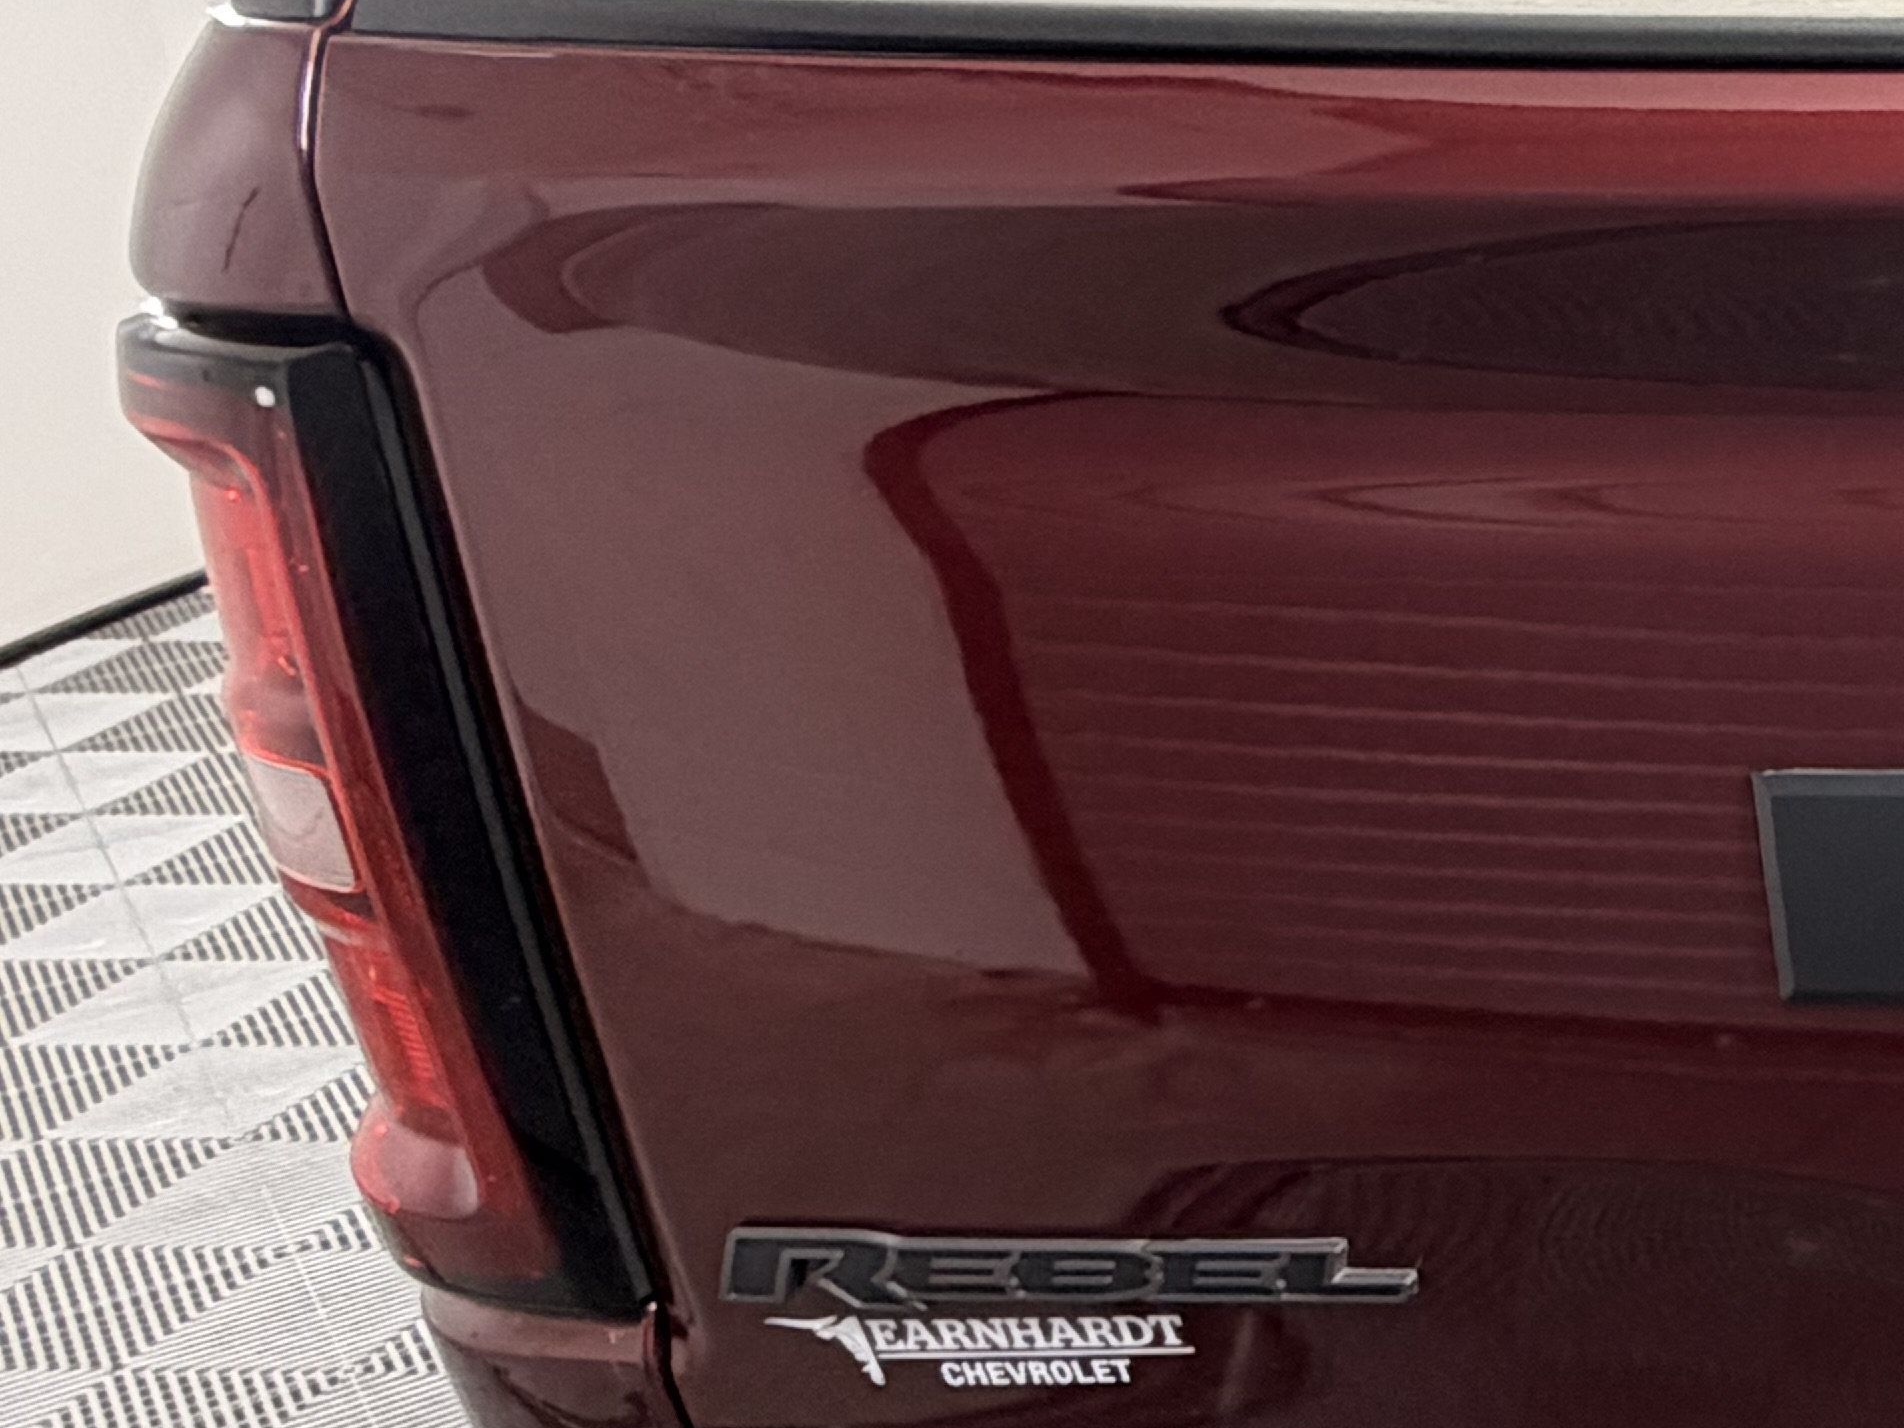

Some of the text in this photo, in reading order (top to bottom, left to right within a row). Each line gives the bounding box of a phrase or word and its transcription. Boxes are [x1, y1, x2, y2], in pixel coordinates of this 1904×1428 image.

[722, 1227, 1418, 1310] REBEL
[867, 1315, 1184, 1352] EARNHARDT
[940, 1358, 1131, 1386] CHEVROLET
